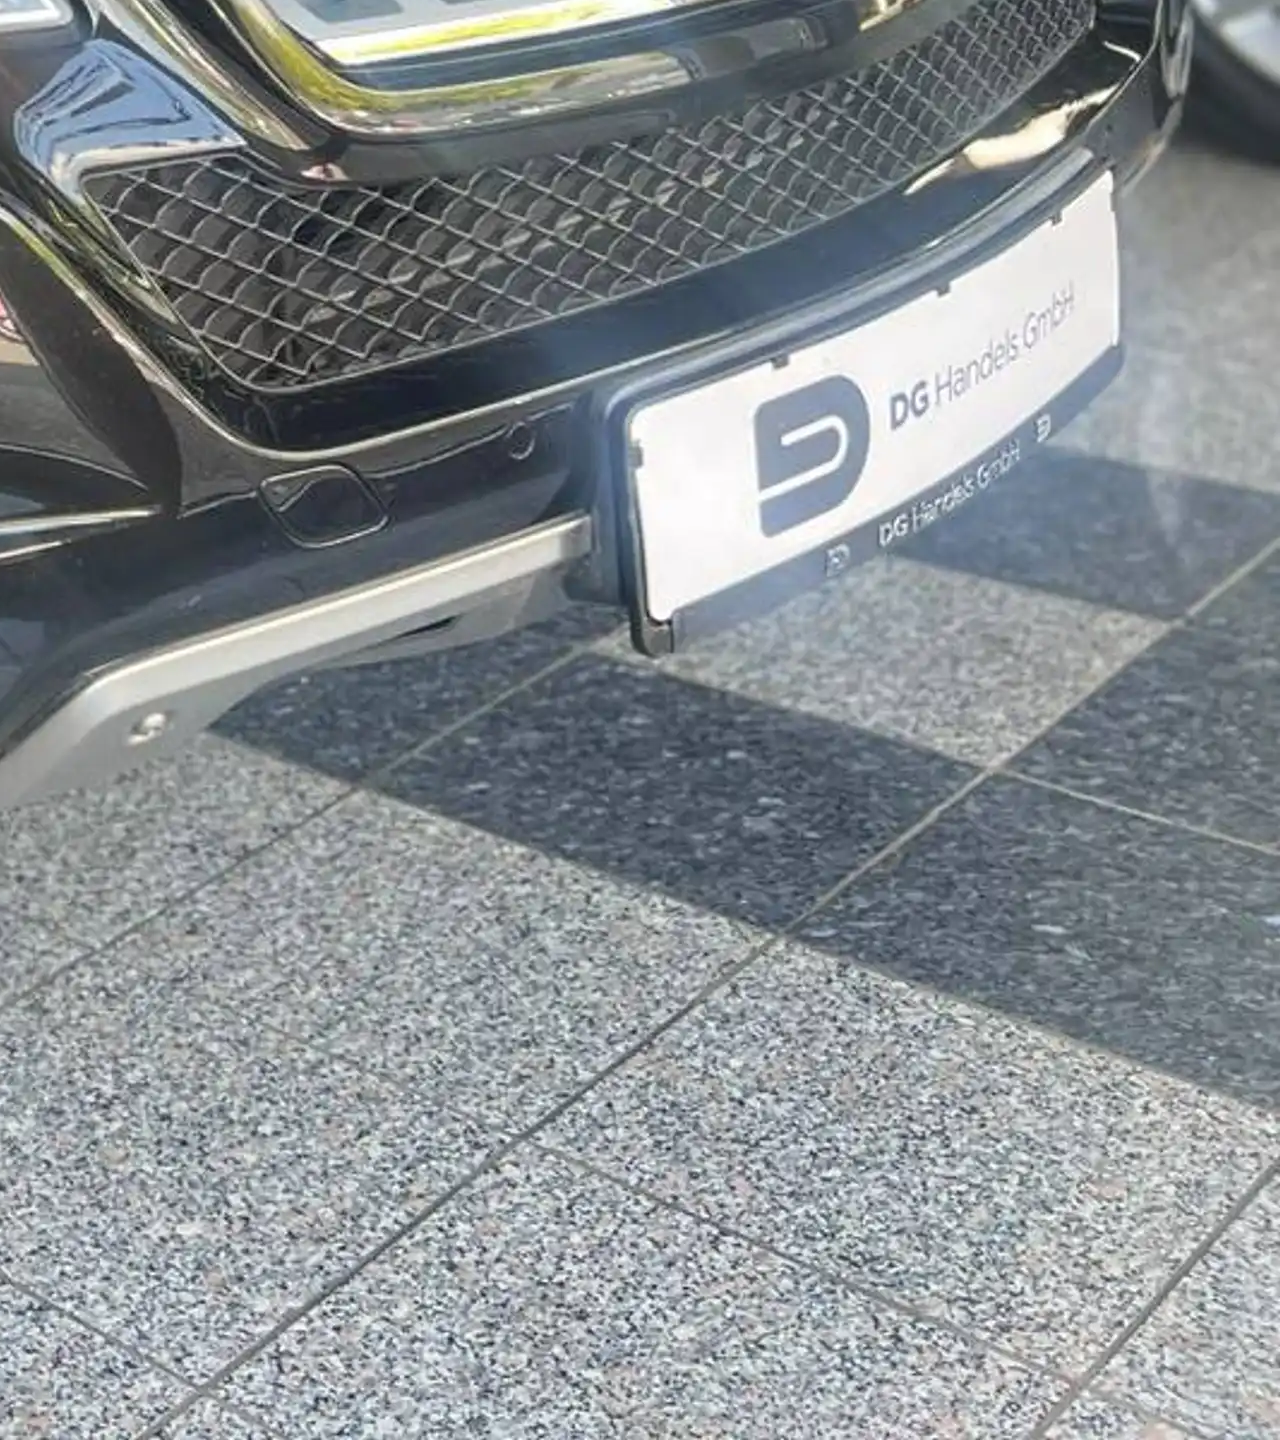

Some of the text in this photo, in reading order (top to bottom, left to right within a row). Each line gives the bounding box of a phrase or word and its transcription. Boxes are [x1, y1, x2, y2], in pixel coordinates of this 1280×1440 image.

[890, 279, 1075, 432] DG Handels GmbH
[878, 439, 1021, 547] DG Handels GmbH
